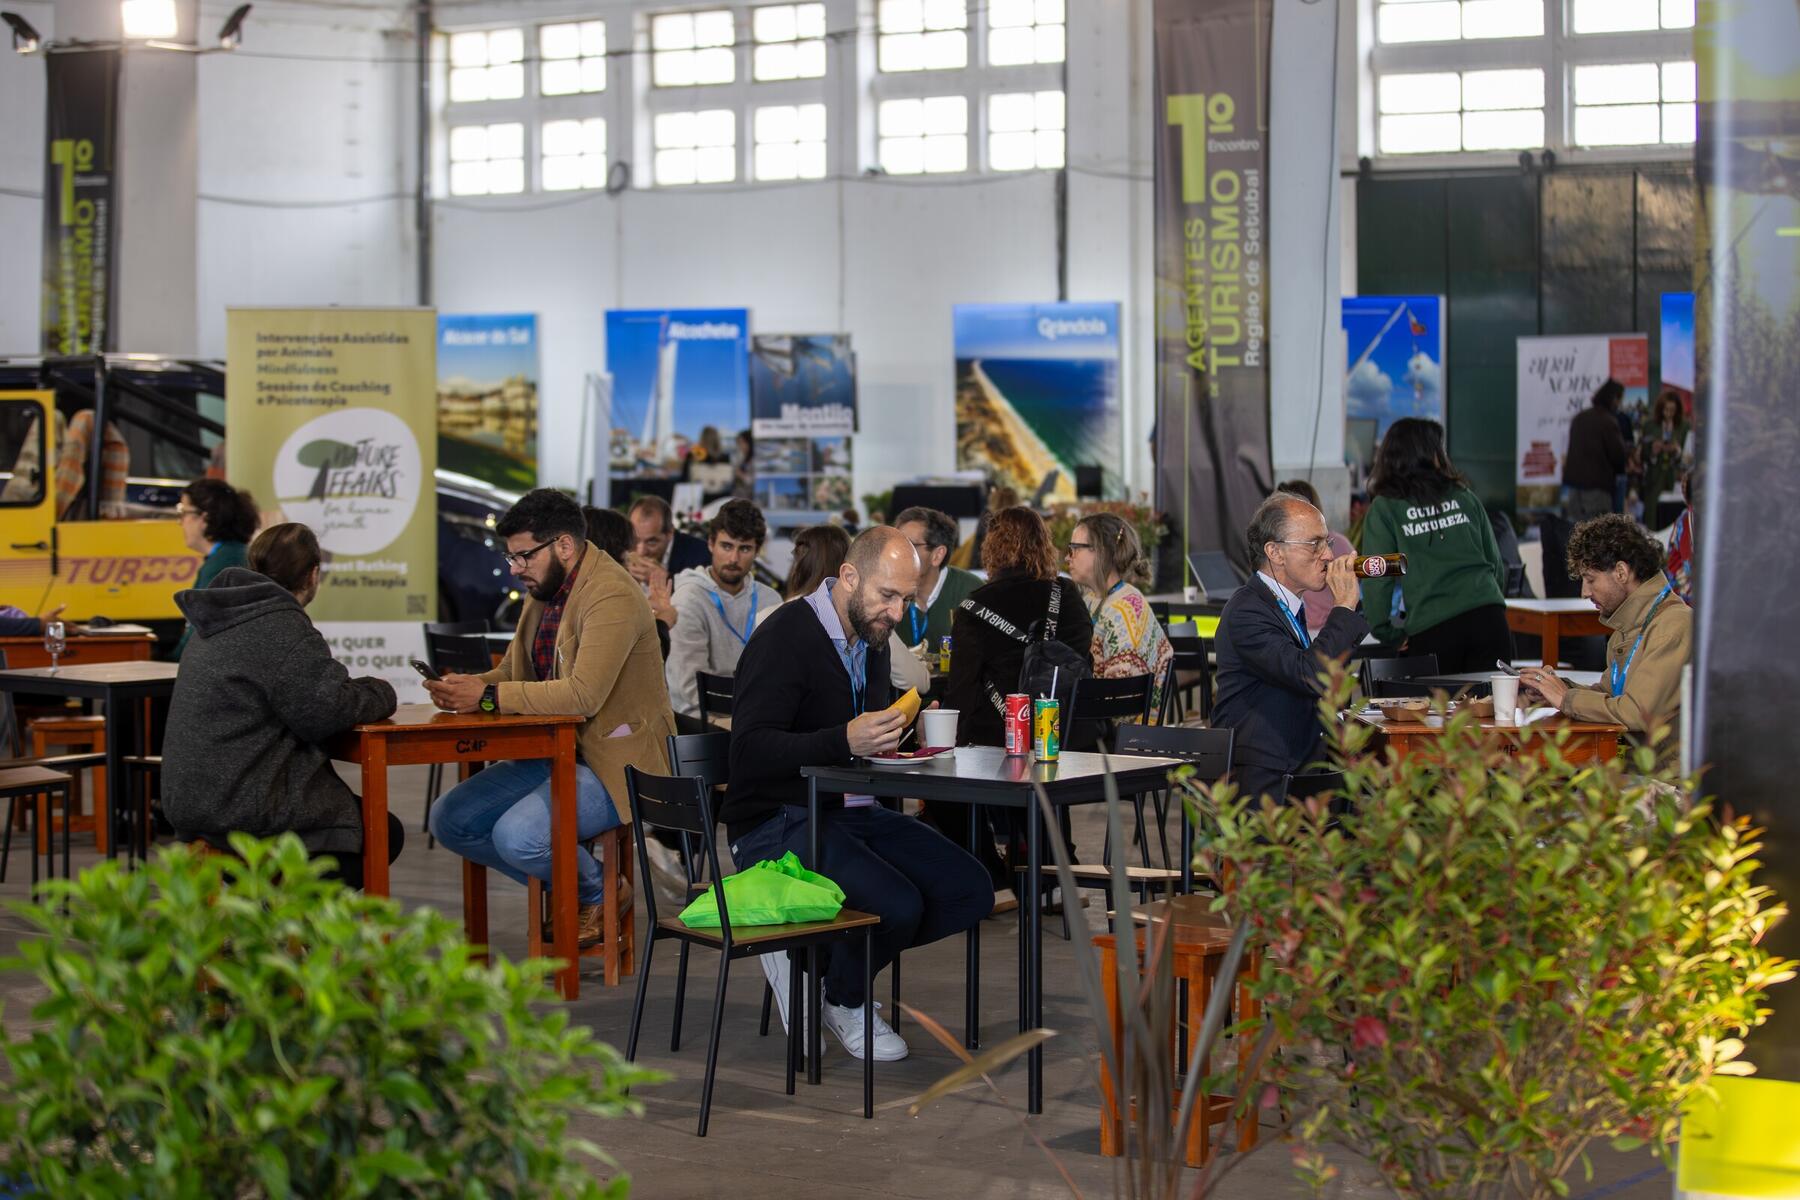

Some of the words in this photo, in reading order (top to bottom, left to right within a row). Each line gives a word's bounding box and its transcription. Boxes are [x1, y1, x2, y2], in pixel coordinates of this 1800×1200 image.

[1208, 139, 1260, 153] Encontro
[1244, 169, 1261, 256] Setúbal
[1209, 169, 1241, 376] TURISMO
[1245, 260, 1260, 285] de
[1185, 217, 1210, 372] AGENTES
[1244, 293, 1264, 367] Região
[256, 333, 339, 345] Intervenções
[342, 333, 409, 344] Assistidas
[257, 349, 277, 359] por
[281, 347, 333, 357] Animais
[257, 381, 309, 392] Sessões
[313, 381, 327, 391] de
[330, 381, 391, 395] Coaching
[268, 396, 347, 407] Psicoterapia
[1440, 499, 1460, 513] DA
[1401, 512, 1470, 537] NATUREZA
[331, 577, 357, 588] Arte
[361, 576, 407, 589] Terapia
[1048, 583, 1062, 614] BIMBAY
[976, 607, 1016, 635] BIMBAY
[342, 637, 385, 651] QUER
[356, 656, 368, 667] O
[372, 656, 404, 670] QUE
